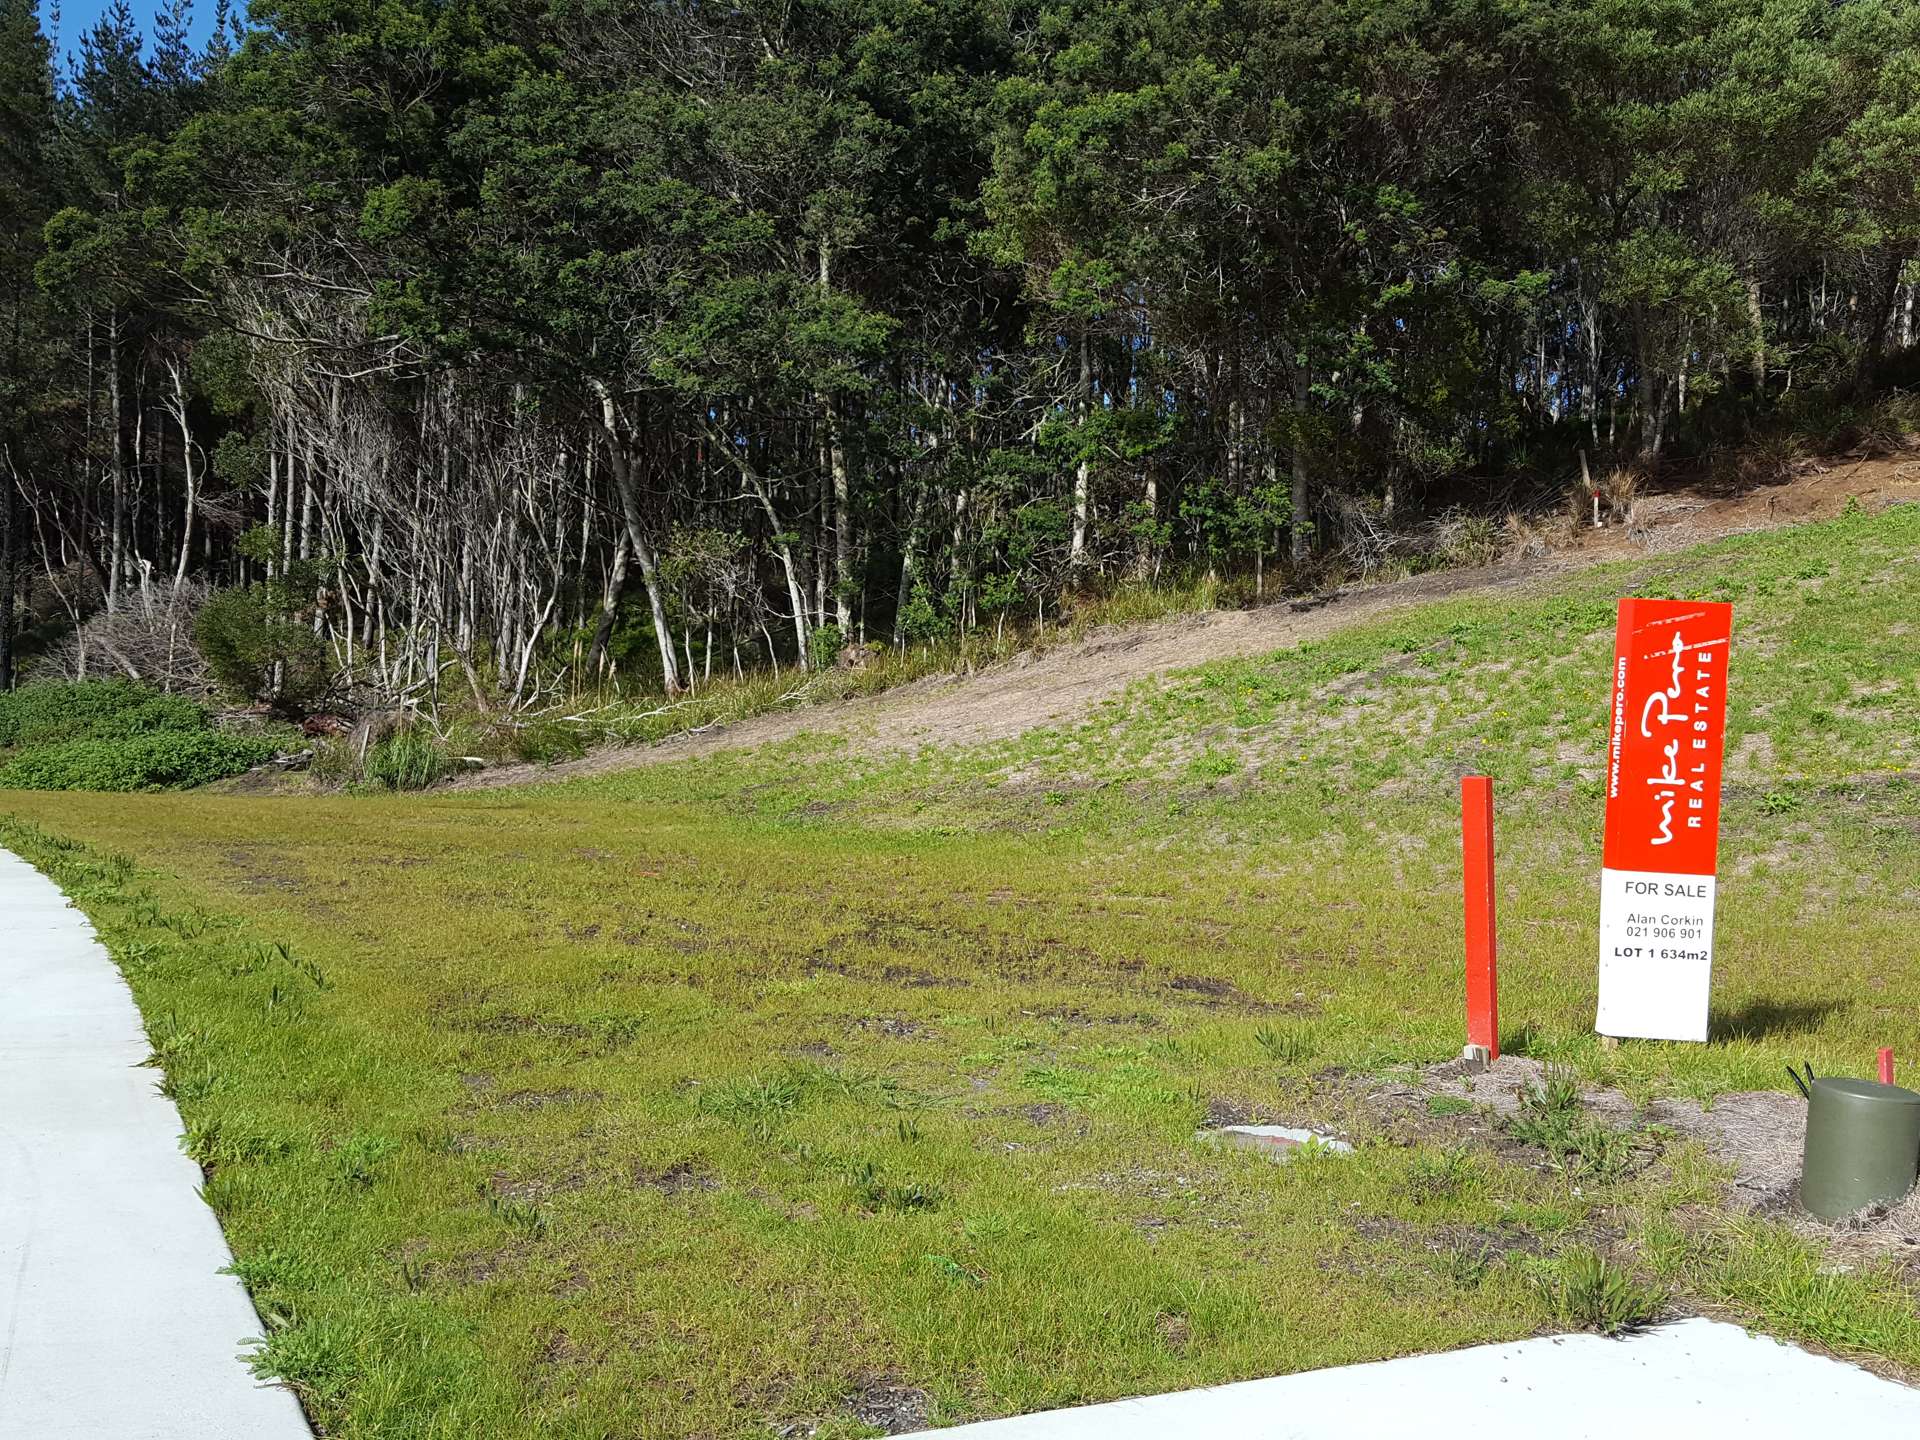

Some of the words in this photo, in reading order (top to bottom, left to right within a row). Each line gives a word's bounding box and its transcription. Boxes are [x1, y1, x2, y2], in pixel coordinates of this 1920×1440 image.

[1641, 631, 1688, 737] Pero
[1692, 651, 1712, 750] ESTATE
[1609, 656, 1627, 799] www.mikepero.com
[1687, 761, 1705, 828] REAL
[1625, 881, 1659, 896] FOR
[1664, 883, 1707, 898] SALE
[1626, 926, 1648, 937] 021
[1653, 927, 1676, 939] 906
[1680, 928, 1701, 939] 901
[1627, 913, 1656, 924] Alan
[1660, 914, 1704, 926] Corkin
[1614, 947, 1643, 958] LOT
[1648, 948, 1655, 958] 1
[1660, 948, 1708, 961] 634m2
